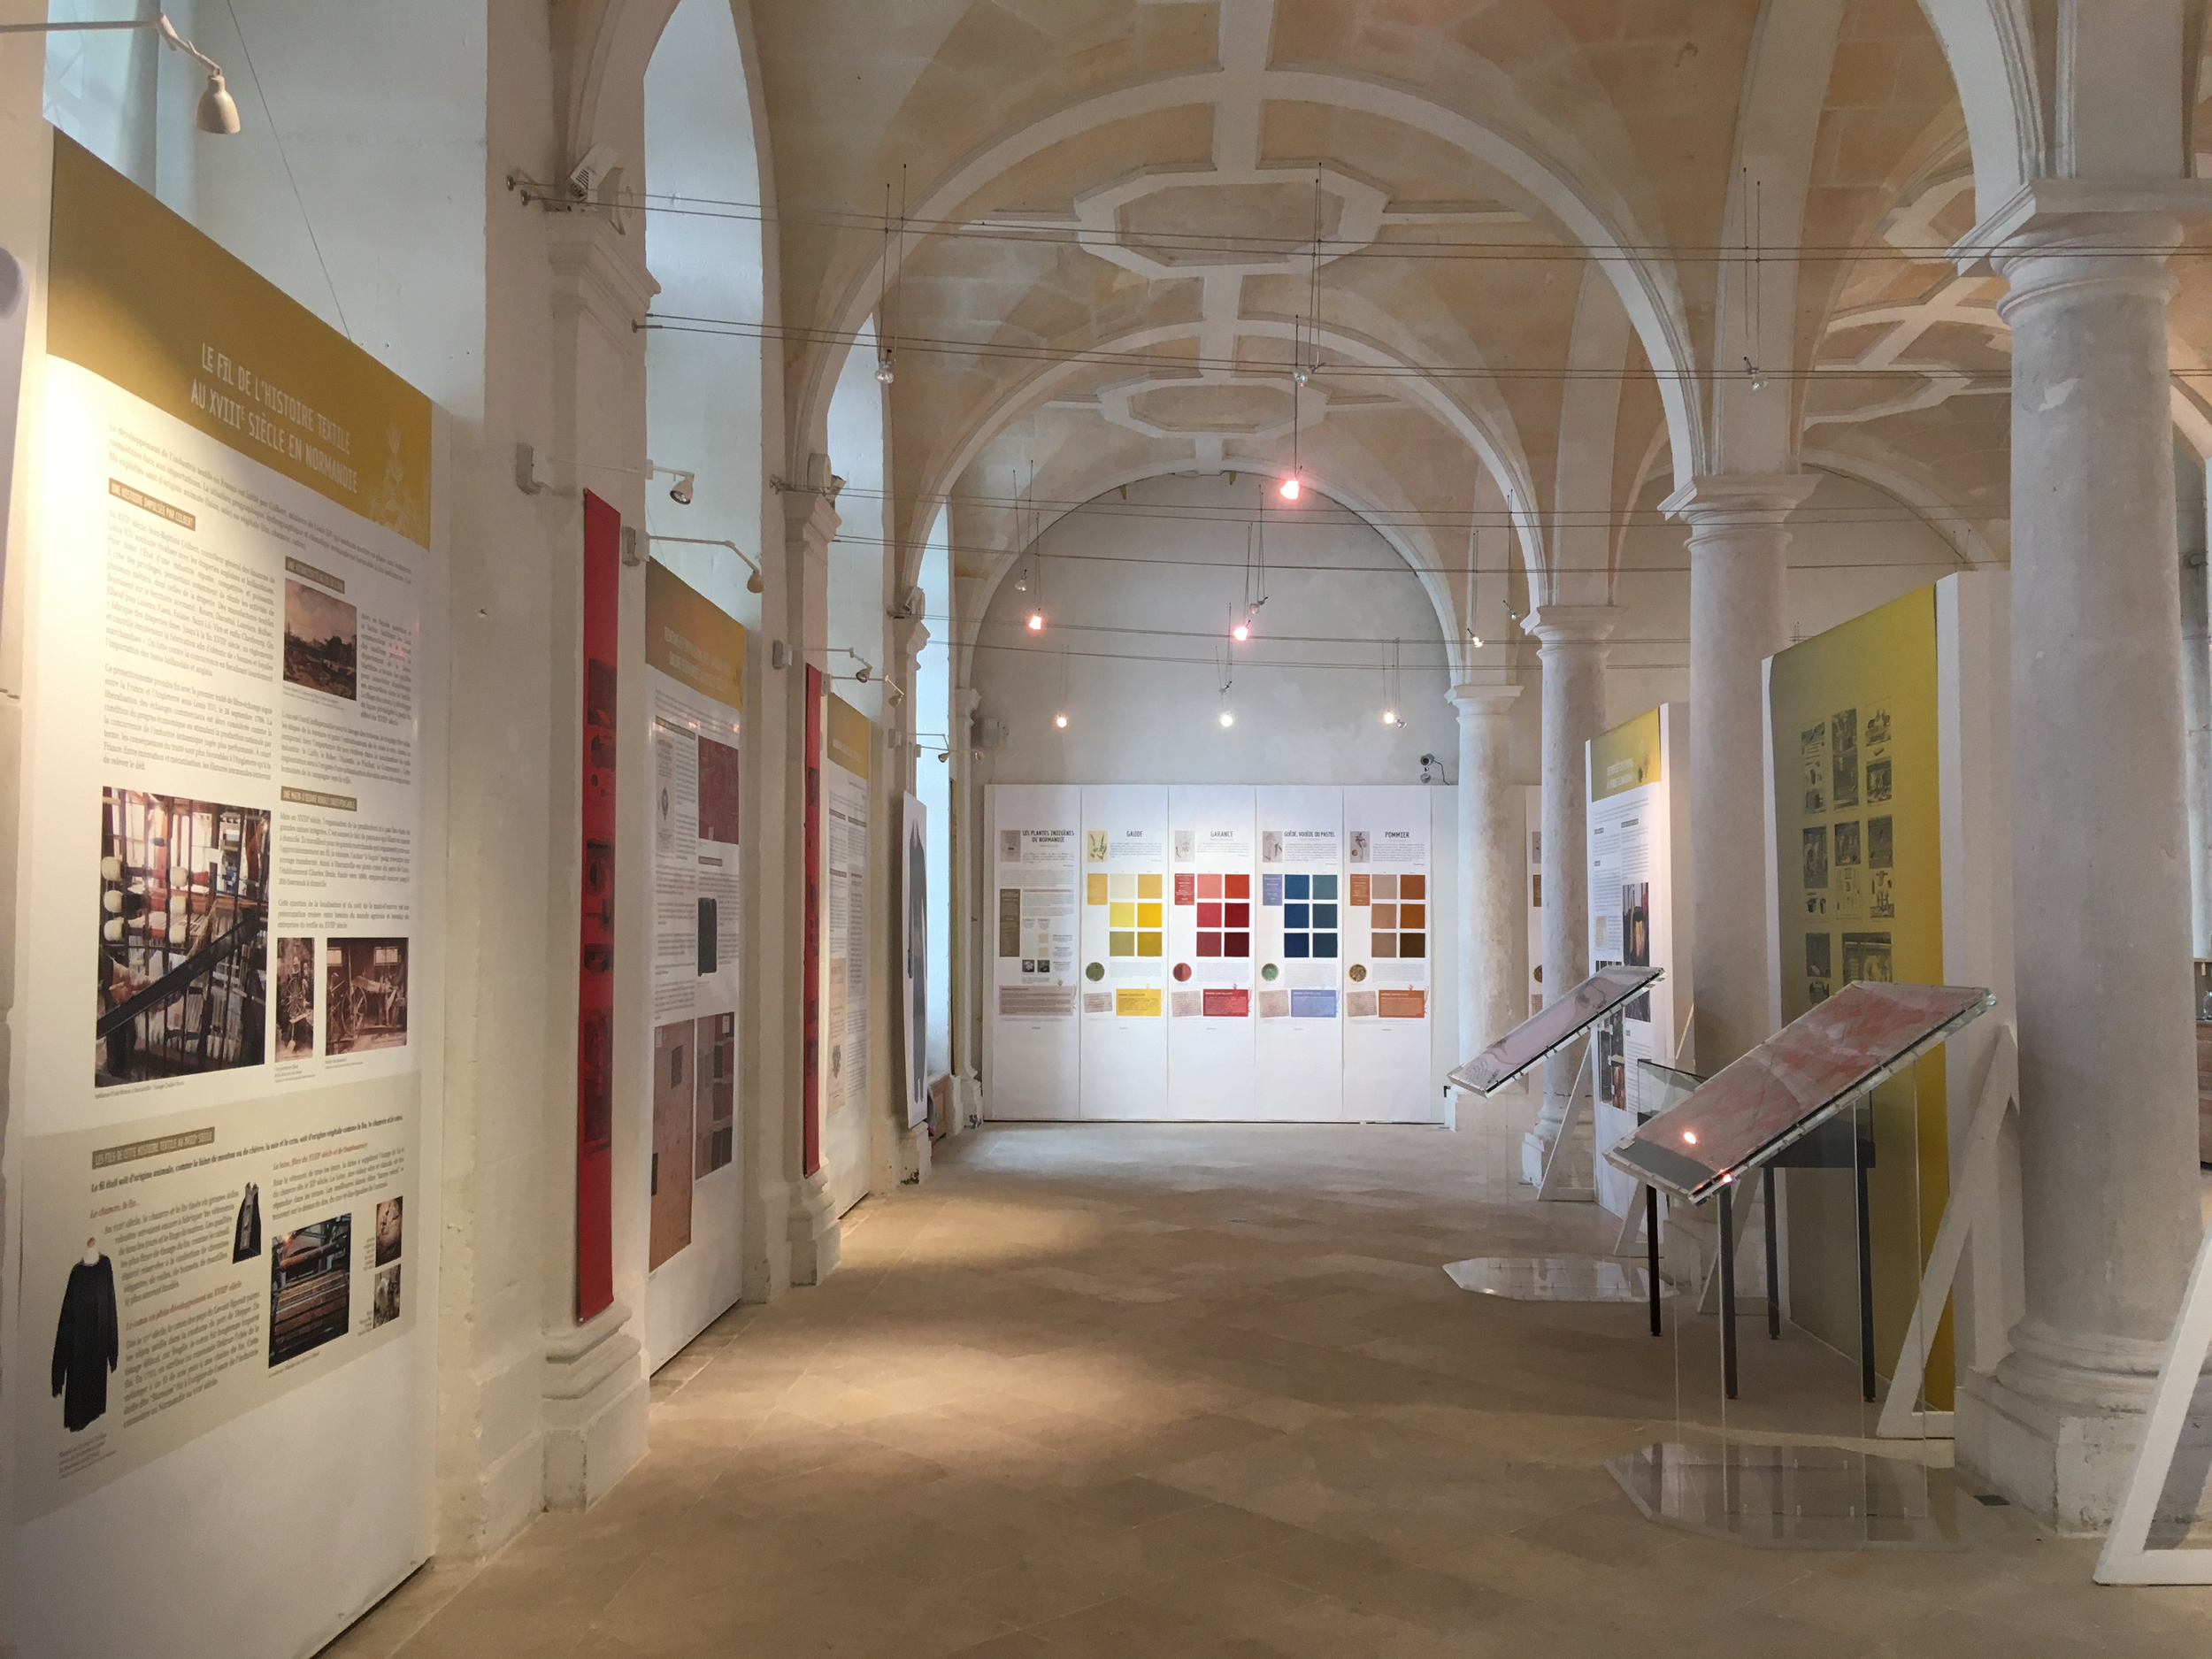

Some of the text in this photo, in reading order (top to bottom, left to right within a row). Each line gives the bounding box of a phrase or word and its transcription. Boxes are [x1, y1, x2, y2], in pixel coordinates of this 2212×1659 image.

[191, 379, 206, 410] AU
[249, 411, 285, 454] SIÈCLE
[288, 434, 302, 463] EN
[305, 443, 358, 494] NORMANDIE
[202, 342, 350, 455] LE FIL DE L'HISTOIRE TEXTILE
